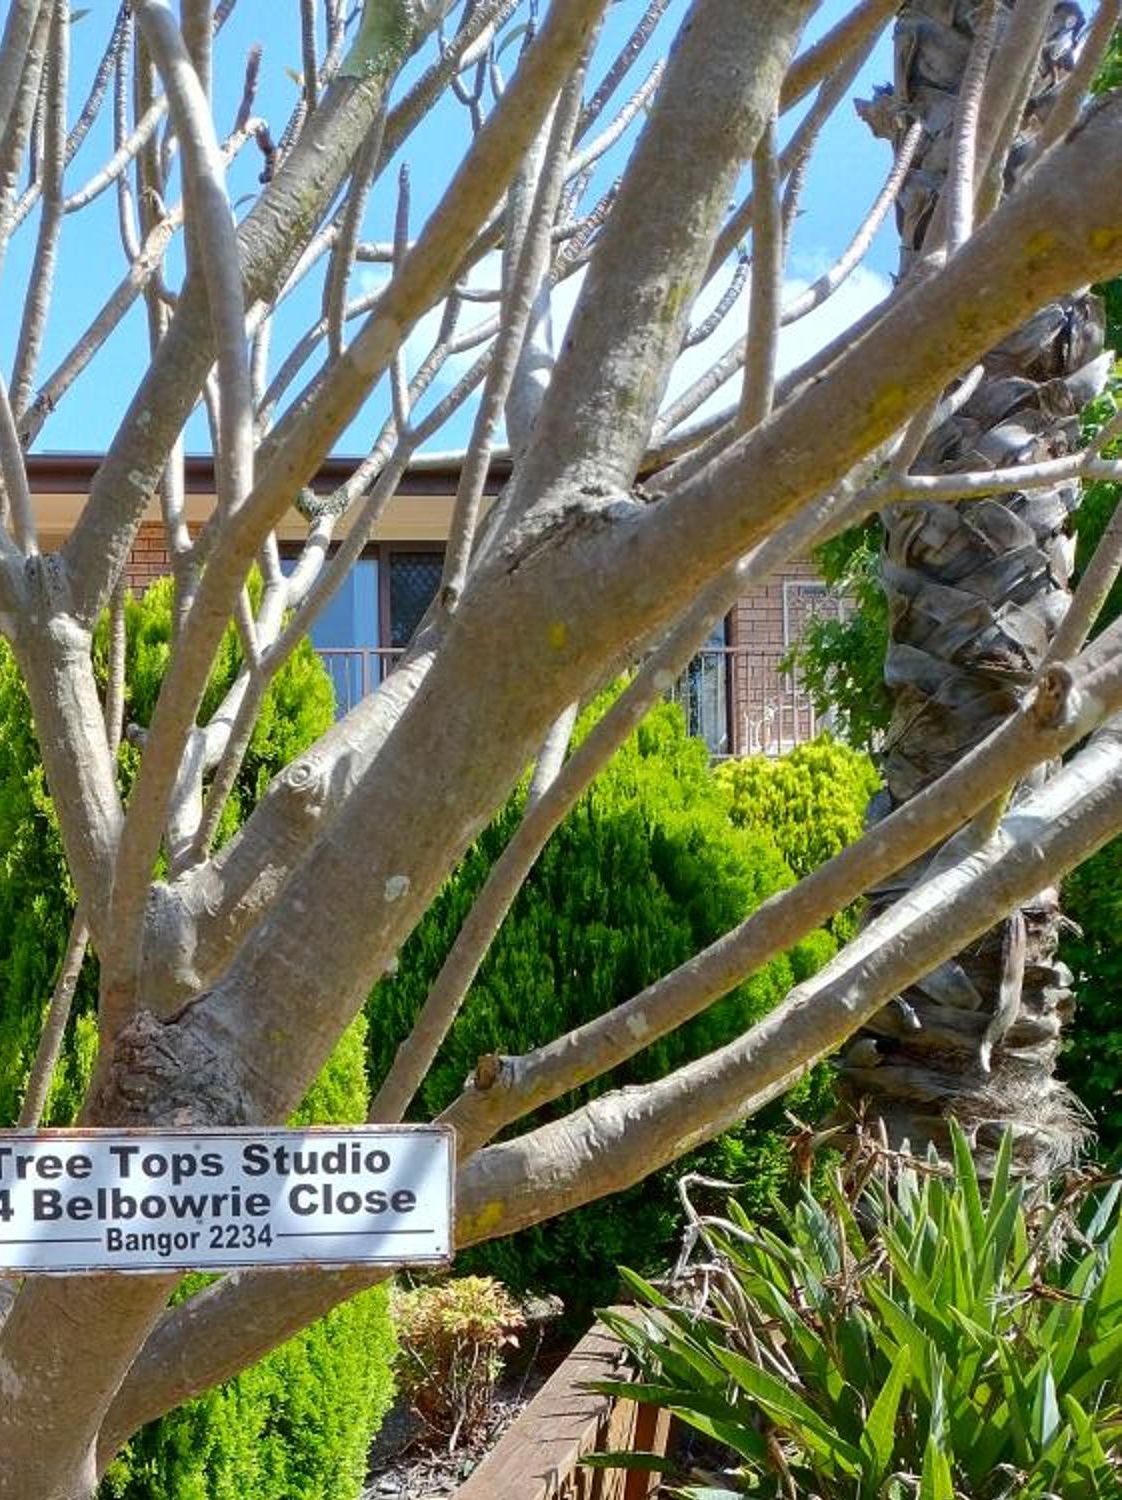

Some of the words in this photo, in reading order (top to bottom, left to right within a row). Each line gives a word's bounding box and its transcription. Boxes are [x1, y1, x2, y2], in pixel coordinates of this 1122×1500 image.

[110, 1144, 224, 1185] Tops
[242, 1142, 391, 1176] Studio
[33, 1185, 271, 1222] Belbowrie
[288, 1183, 417, 1216] Close
[106, 1225, 201, 1257] Bangor
[209, 1224, 273, 1250] 2234
